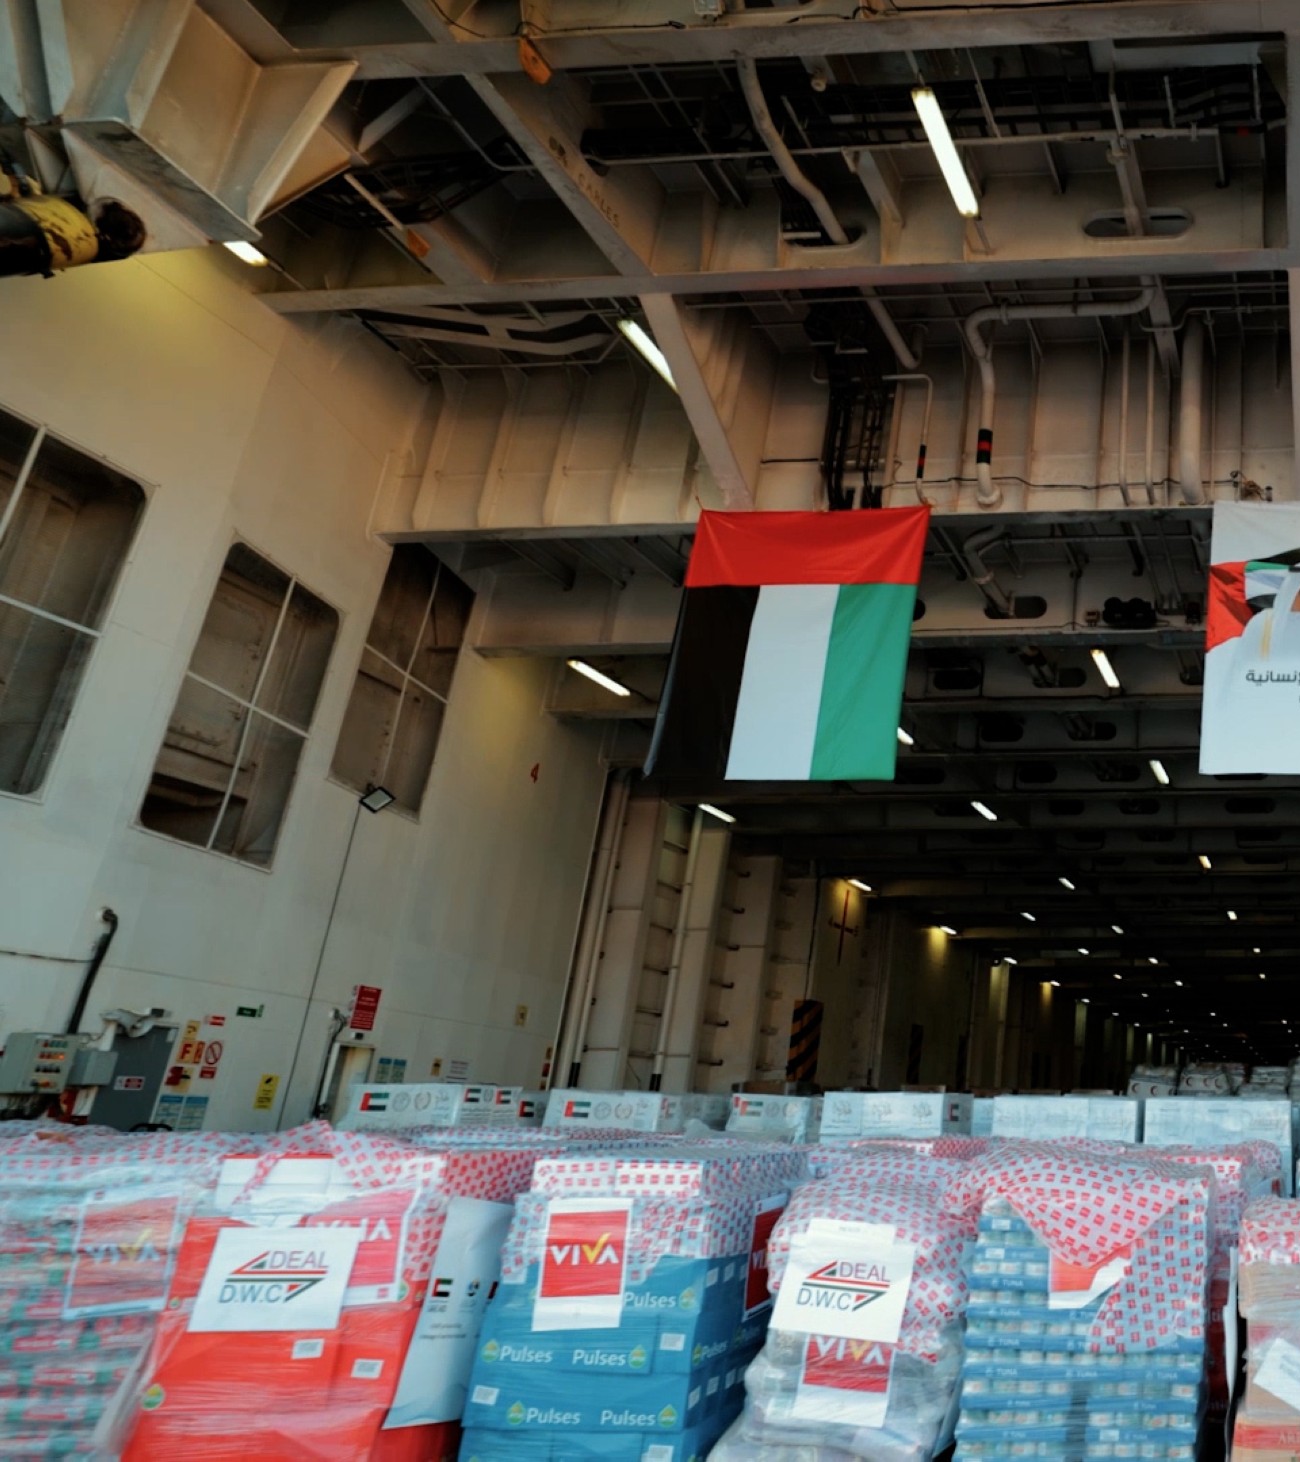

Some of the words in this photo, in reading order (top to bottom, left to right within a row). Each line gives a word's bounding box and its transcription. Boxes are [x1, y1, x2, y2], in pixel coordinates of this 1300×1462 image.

[549, 1232, 619, 1266] VIVA
[218, 1284, 283, 1304] D.W.C
[623, 1291, 676, 1309] Pulses
[796, 1288, 852, 1311] D.W.C
[500, 1345, 554, 1363] Pulses
[572, 1349, 627, 1366] Pulses
[815, 1335, 887, 1366] VIVA
[524, 1407, 581, 1425] Pulses
[600, 1409, 657, 1427] Pulses
